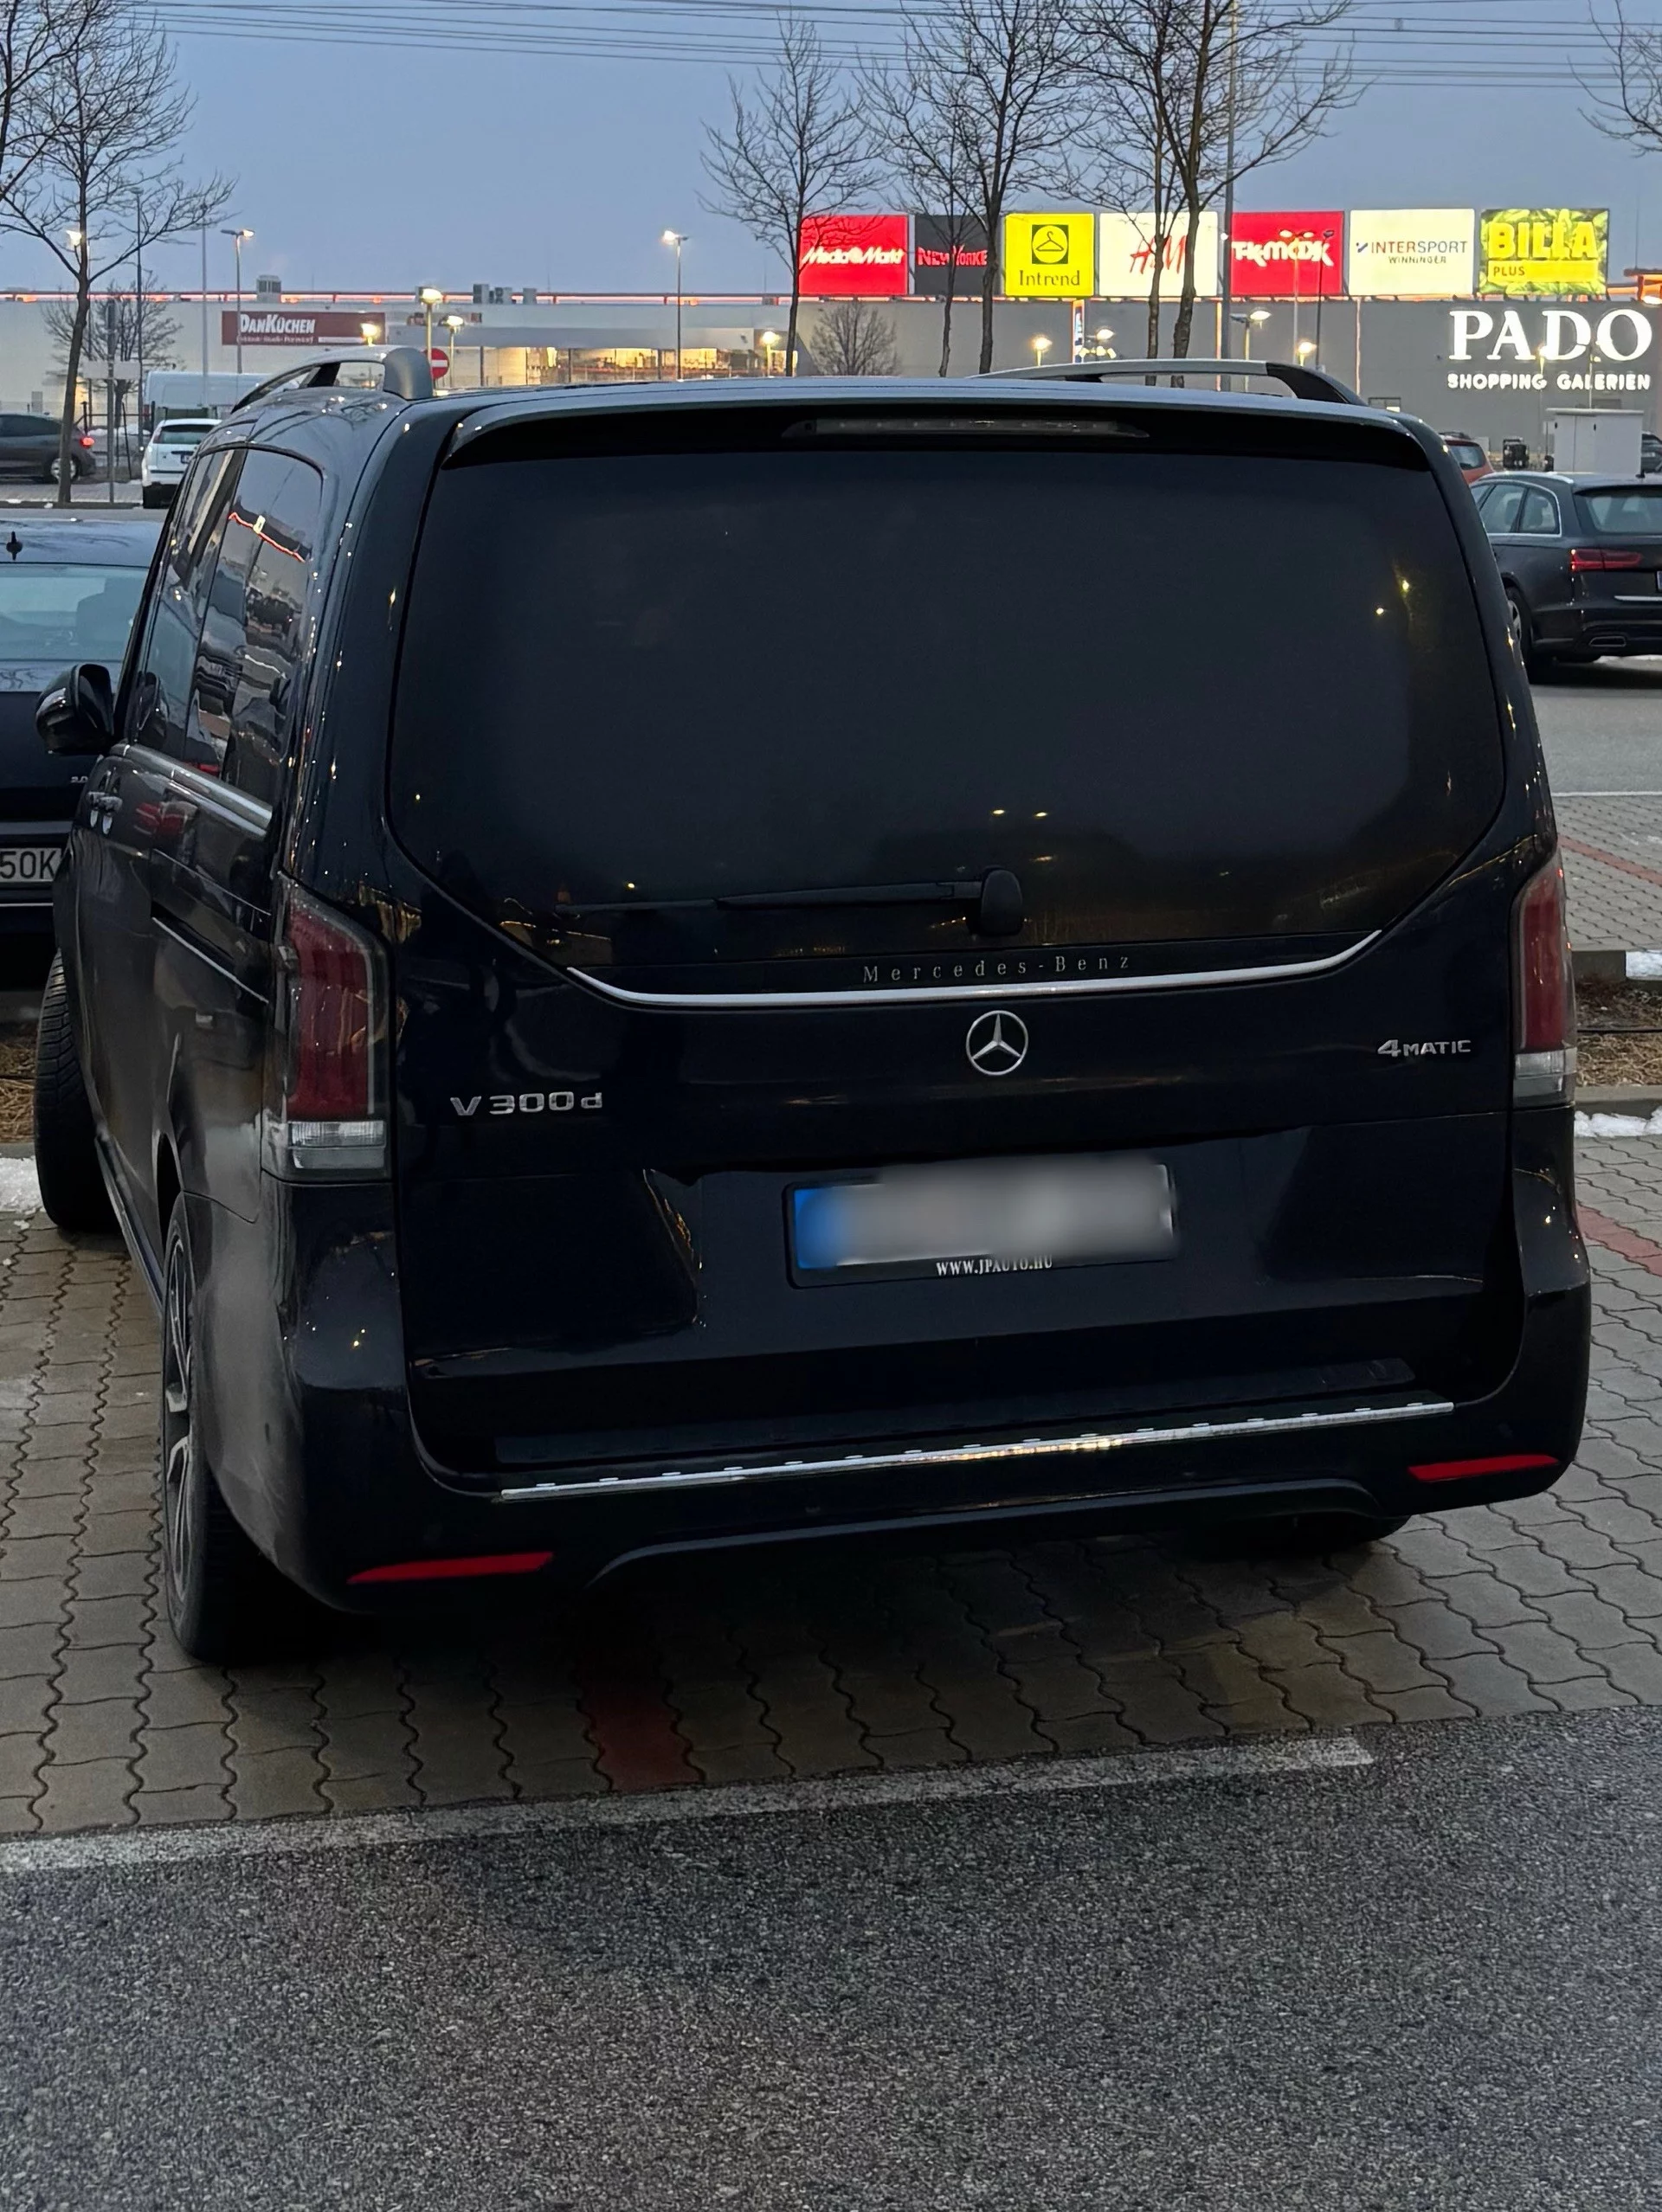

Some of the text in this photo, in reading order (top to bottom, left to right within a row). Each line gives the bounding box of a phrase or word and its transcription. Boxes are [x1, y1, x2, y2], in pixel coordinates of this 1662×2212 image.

[1371, 241, 1468, 254] INTERSPORT
[1488, 221, 1599, 259] BILLA
[953, 244, 989, 266] YORKE
[1130, 235, 1188, 274] HM
[1019, 270, 1080, 286] Intrend
[1493, 265, 1526, 277] PLUS
[1448, 308, 1653, 362] PADO
[1447, 373, 1651, 391] SHOPPING GALERIEN
[863, 955, 1130, 983] Mercedes-Benz
[1377, 1039, 1472, 1058] 4MATIC
[450, 1091, 603, 1116] V 300d
